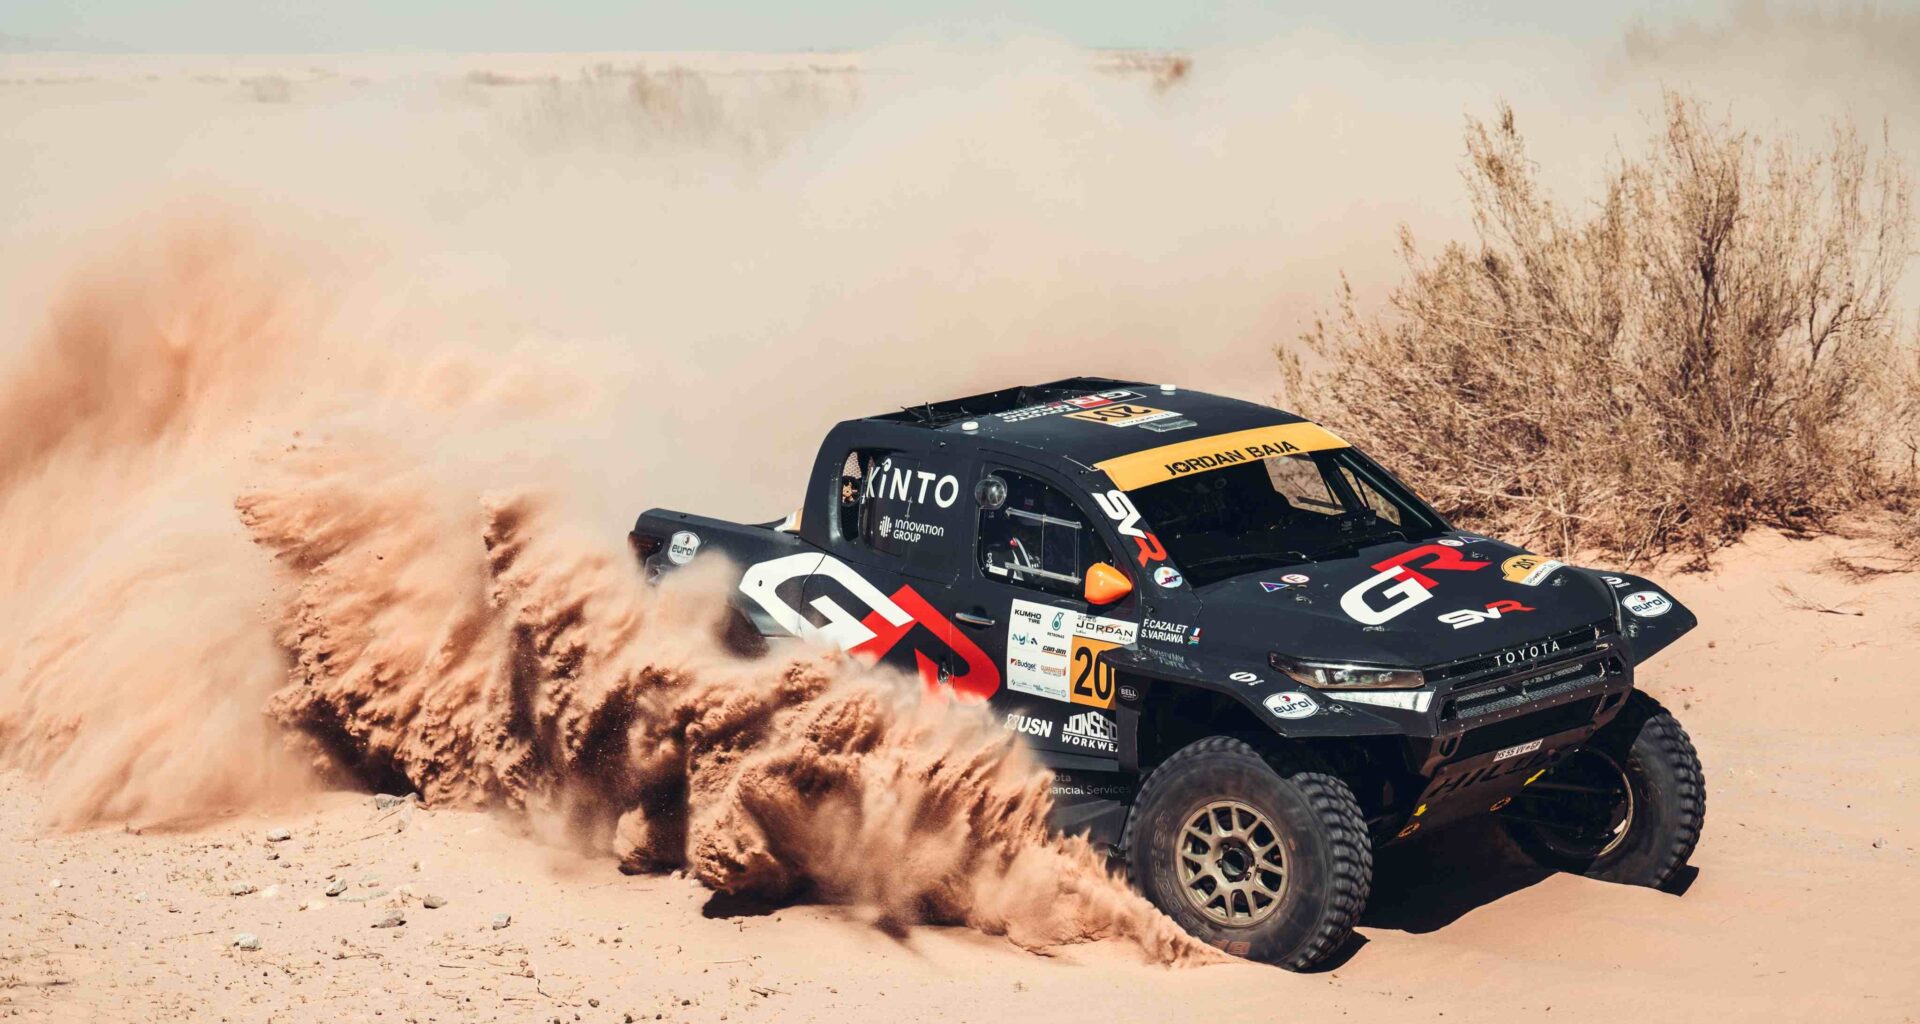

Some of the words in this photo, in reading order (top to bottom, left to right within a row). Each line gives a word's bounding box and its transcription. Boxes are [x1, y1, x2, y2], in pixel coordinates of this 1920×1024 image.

[1074, 406, 1151, 421] 201
[1165, 449, 1246, 476] JORDAN
[1245, 440, 1300, 458] BAJA
[893, 529, 921, 543] GROUP
[1091, 490, 1168, 568] SVR
[672, 544, 695, 557] eurol
[1340, 544, 1492, 625] GR
[1631, 596, 1666, 612] eurol
[1014, 609, 1042, 620] KUMHO
[1437, 600, 1536, 630] SVR
[738, 552, 1000, 702] GR
[1076, 620, 1134, 637] JORDAN
[1143, 618, 1188, 634] F.CAZALET
[1141, 629, 1184, 644] S.VARIAWA
[1494, 640, 1560, 666] TOYOTA
[1017, 659, 1037, 671] Budget
[1121, 688, 1136, 697] BELL
[1273, 698, 1313, 714] eurol
[1017, 716, 1053, 738] USN
